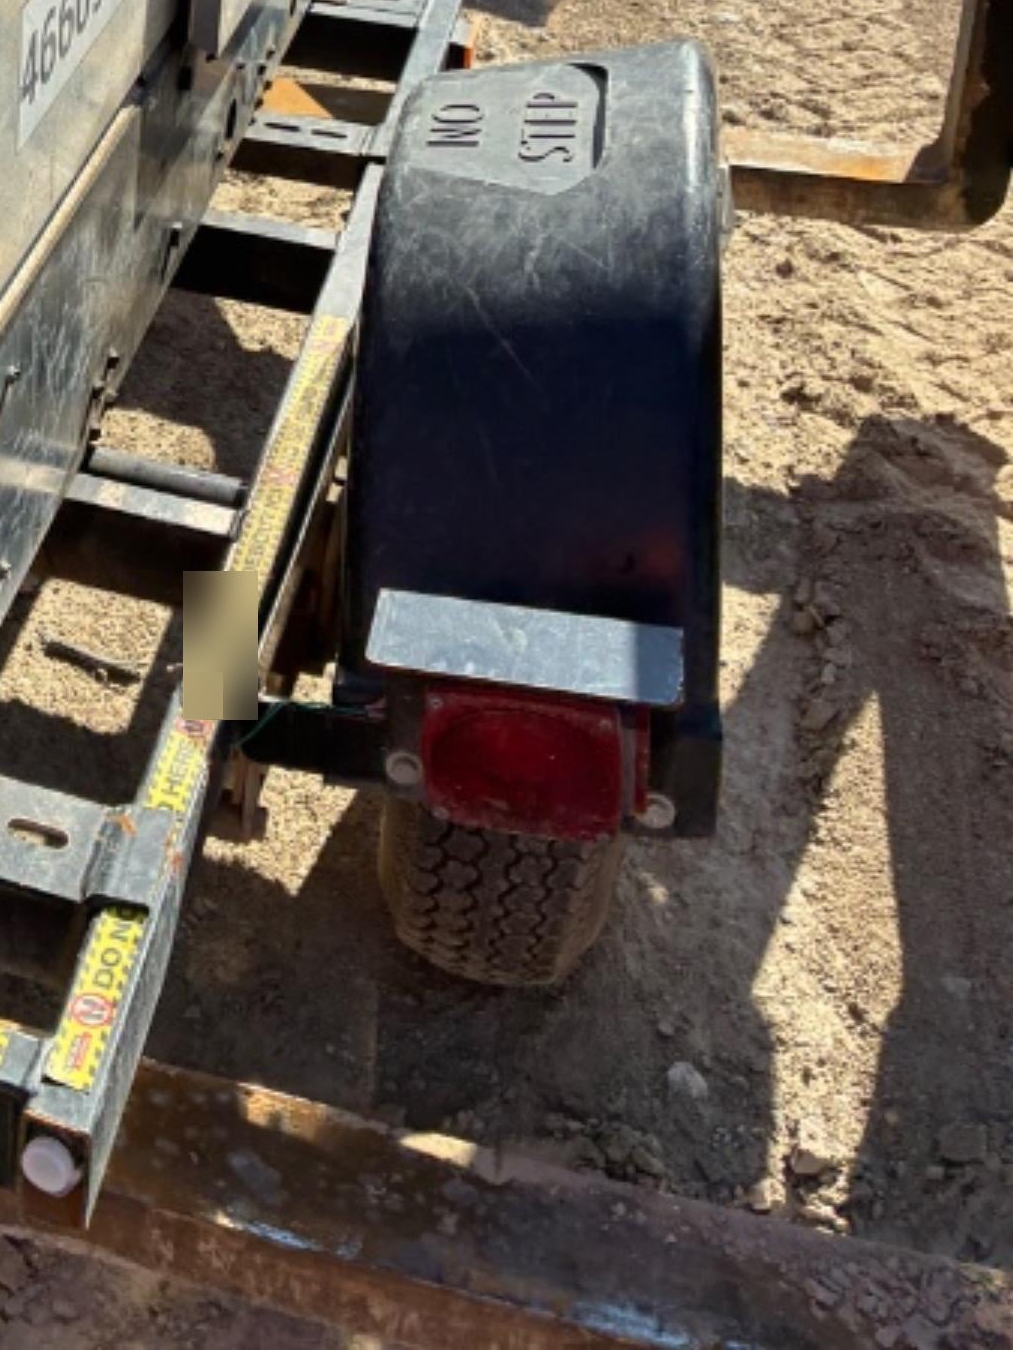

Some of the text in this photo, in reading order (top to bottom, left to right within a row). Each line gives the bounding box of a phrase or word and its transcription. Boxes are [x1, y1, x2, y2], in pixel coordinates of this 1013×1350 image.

[425, 103, 485, 148] NO
[517, 91, 579, 163] STEP
[92, 946, 123, 991] DO
